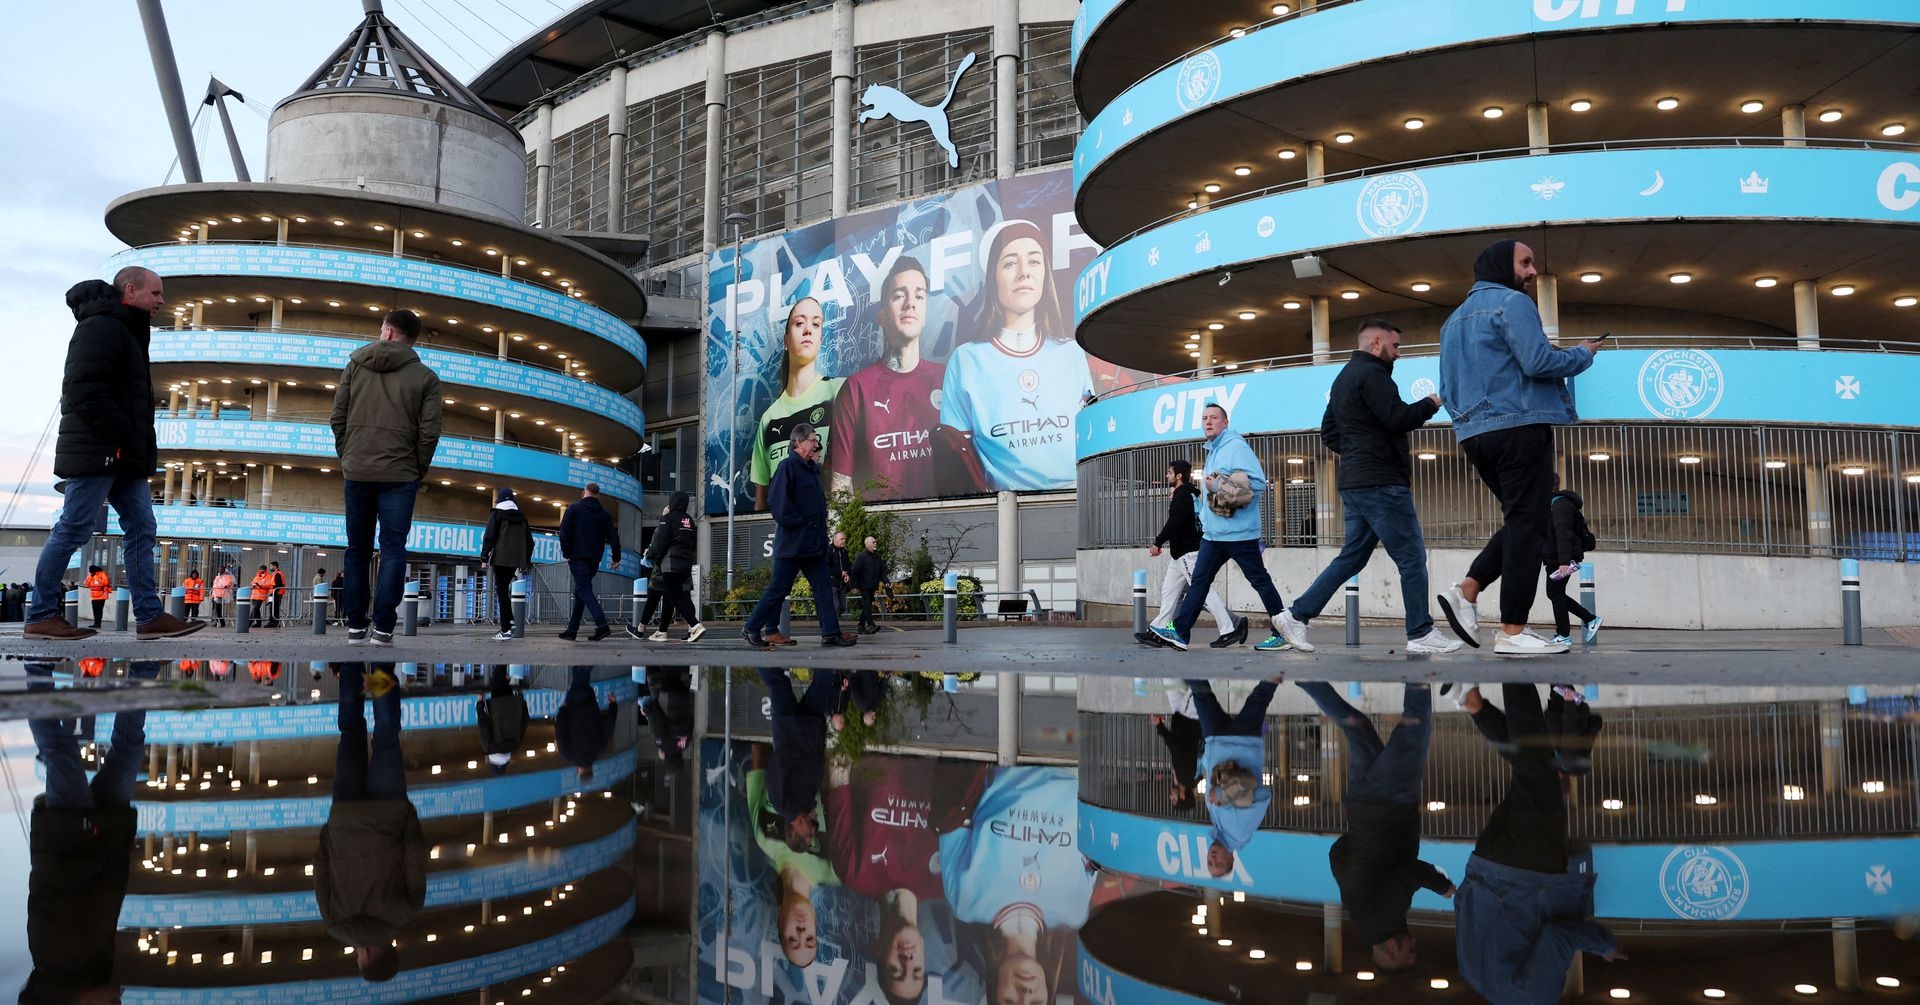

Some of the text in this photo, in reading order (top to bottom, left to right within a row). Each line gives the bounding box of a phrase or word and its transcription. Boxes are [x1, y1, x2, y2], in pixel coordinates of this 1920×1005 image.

[1366, 175, 1422, 197] MANCHESTER
[1377, 227, 1398, 235] CITY
[725, 246, 904, 332] PLAY
[1077, 256, 1112, 313] CITY
[1650, 351, 1716, 380] MANCHESTER
[1153, 383, 1247, 434] CITY
[1663, 408, 1688, 418] CITY
[990, 415, 1070, 438] ETIHAD
[873, 429, 930, 449] ETIHA
[1008, 433, 1063, 449] AIRWAYS
[889, 446, 933, 462] AIRWAY
